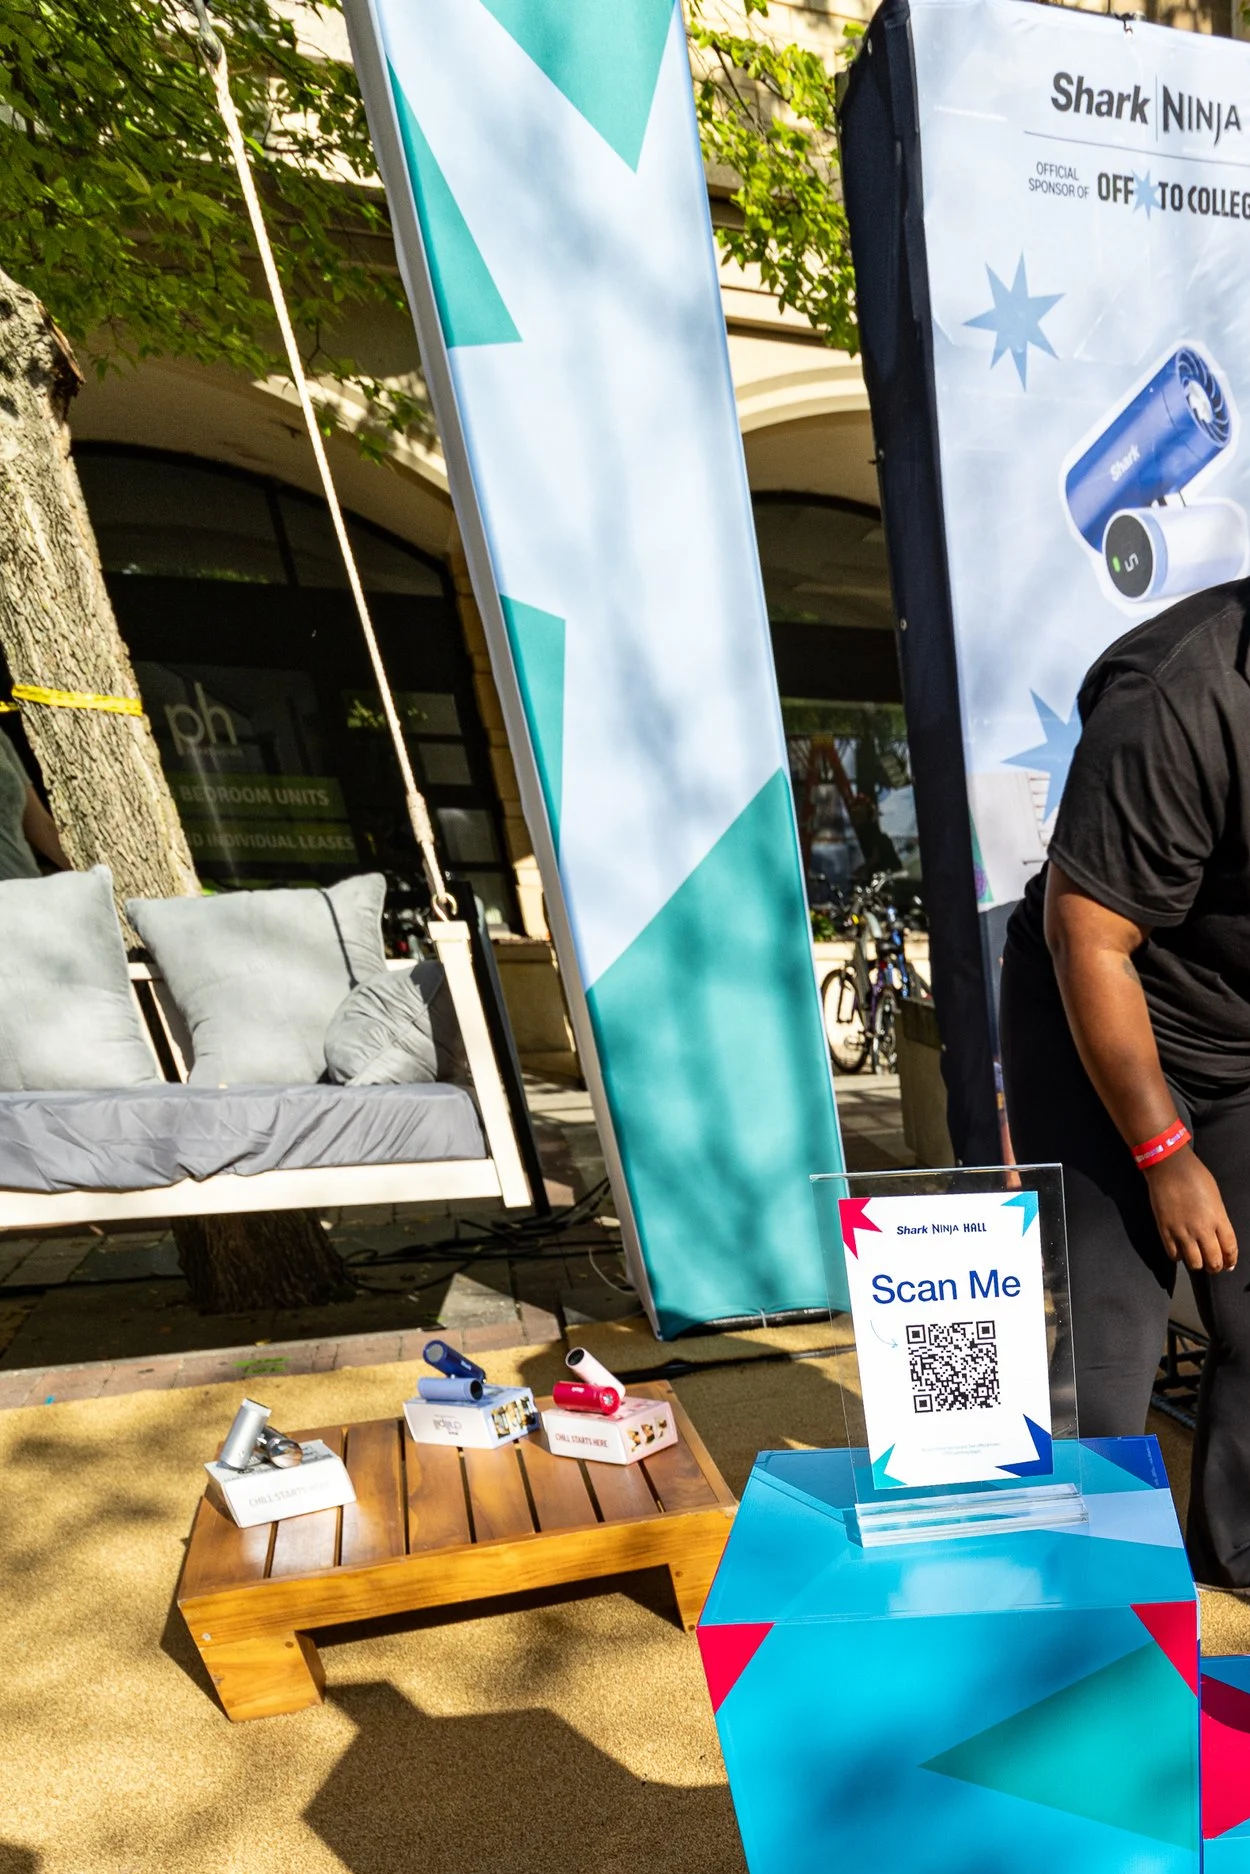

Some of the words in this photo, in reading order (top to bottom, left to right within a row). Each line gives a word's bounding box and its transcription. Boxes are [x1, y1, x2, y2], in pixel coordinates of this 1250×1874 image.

[1051, 72, 1151, 124] Shark
[1163, 84, 1241, 147] NINJA
[1036, 162, 1079, 181] OFFICIAL
[1028, 178, 1075, 198] SPONSOR
[1077, 186, 1089, 199] OF
[1098, 173, 1134, 204] OFF
[1159, 182, 1183, 212] TO
[1109, 443, 1141, 481] Shark
[164, 682, 238, 757] ph
[179, 785, 270, 805] BEDROOM
[275, 787, 329, 806] UNITS
[207, 832, 298, 850] INDIVIDUAL
[299, 833, 355, 850] LEASES
[896, 1225, 928, 1236] Shark
[932, 1223, 959, 1235] NINJA
[964, 1222, 987, 1233] HALL
[872, 1274, 958, 1304] Scan
[969, 1269, 1021, 1299] Me
